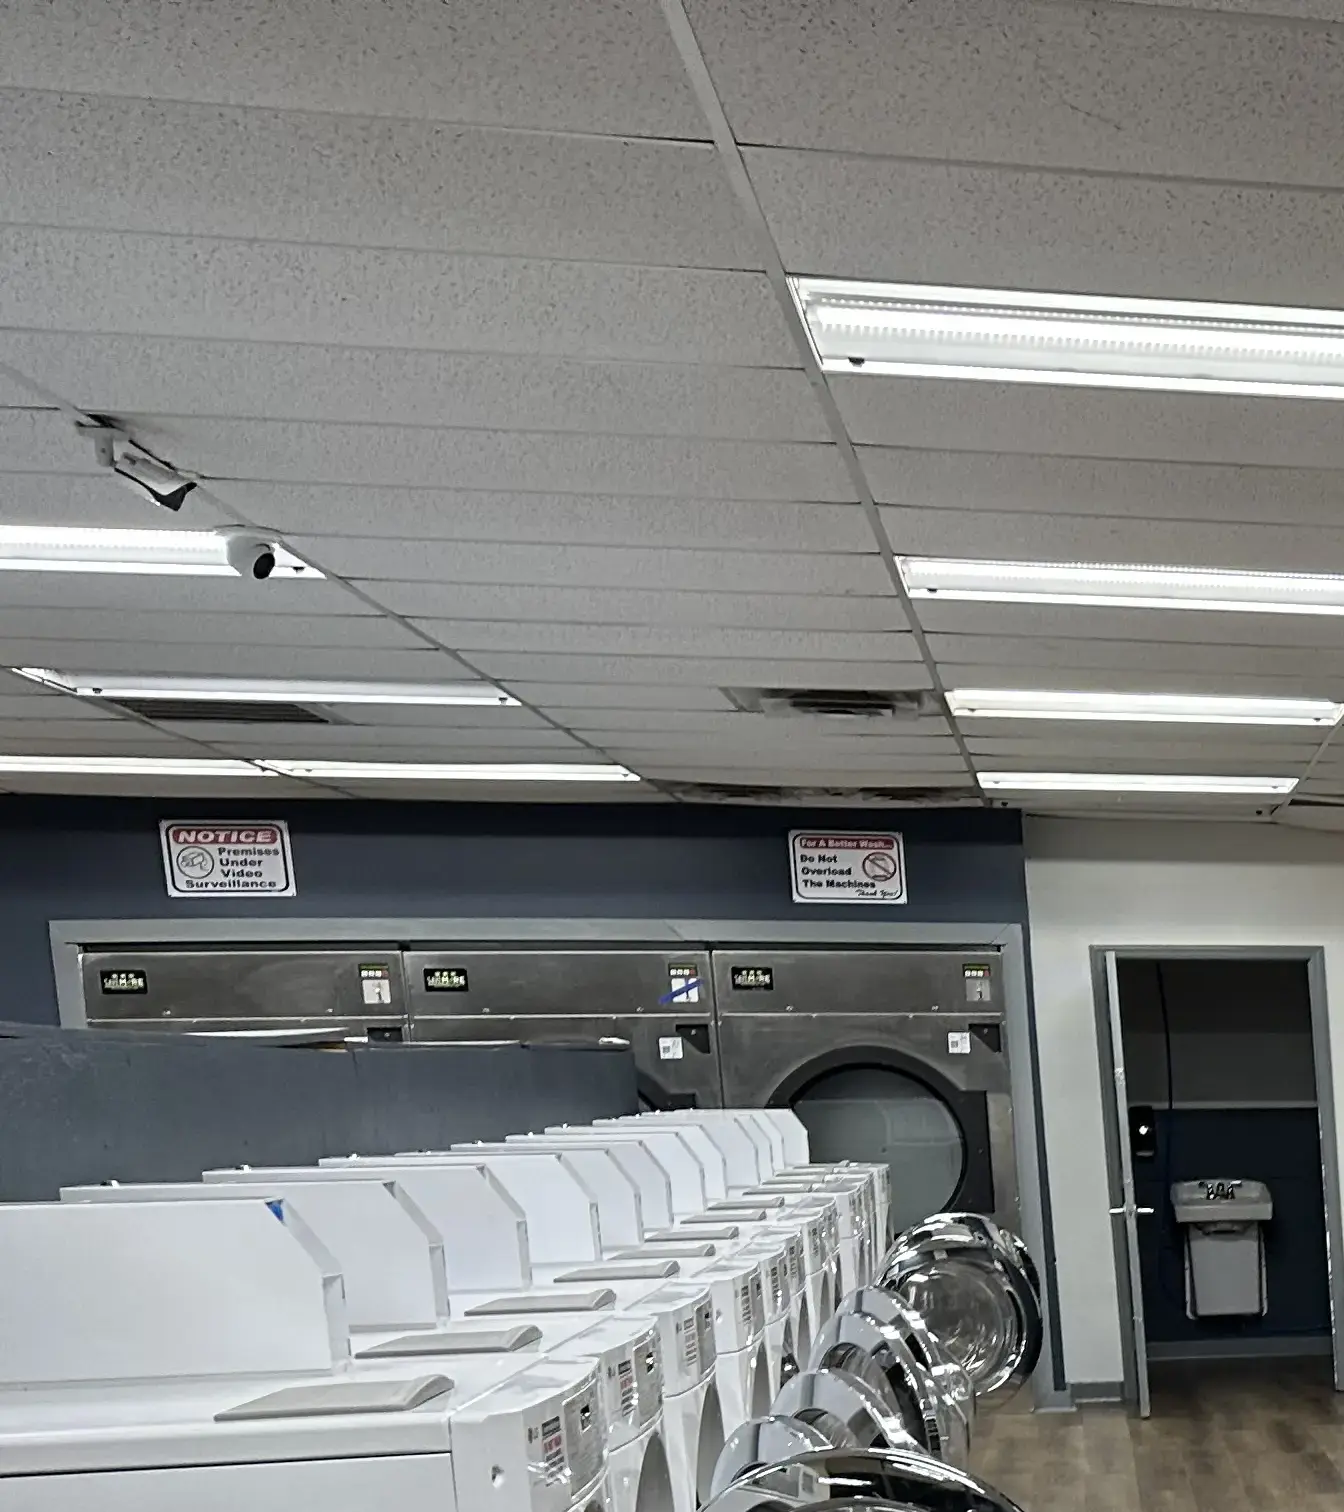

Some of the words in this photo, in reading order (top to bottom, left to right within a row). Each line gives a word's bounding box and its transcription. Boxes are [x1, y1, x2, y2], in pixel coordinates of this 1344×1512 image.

[178, 830, 272, 843] NOTICE
[218, 847, 279, 856] Premises
[219, 858, 263, 866] Under
[800, 854, 814, 863] Do
[818, 854, 838, 863] Not
[220, 869, 263, 878] Video
[801, 867, 852, 876] Overload
[185, 880, 277, 888] Surveillance
[802, 880, 822, 888] The
[826, 880, 876, 888] Machines
